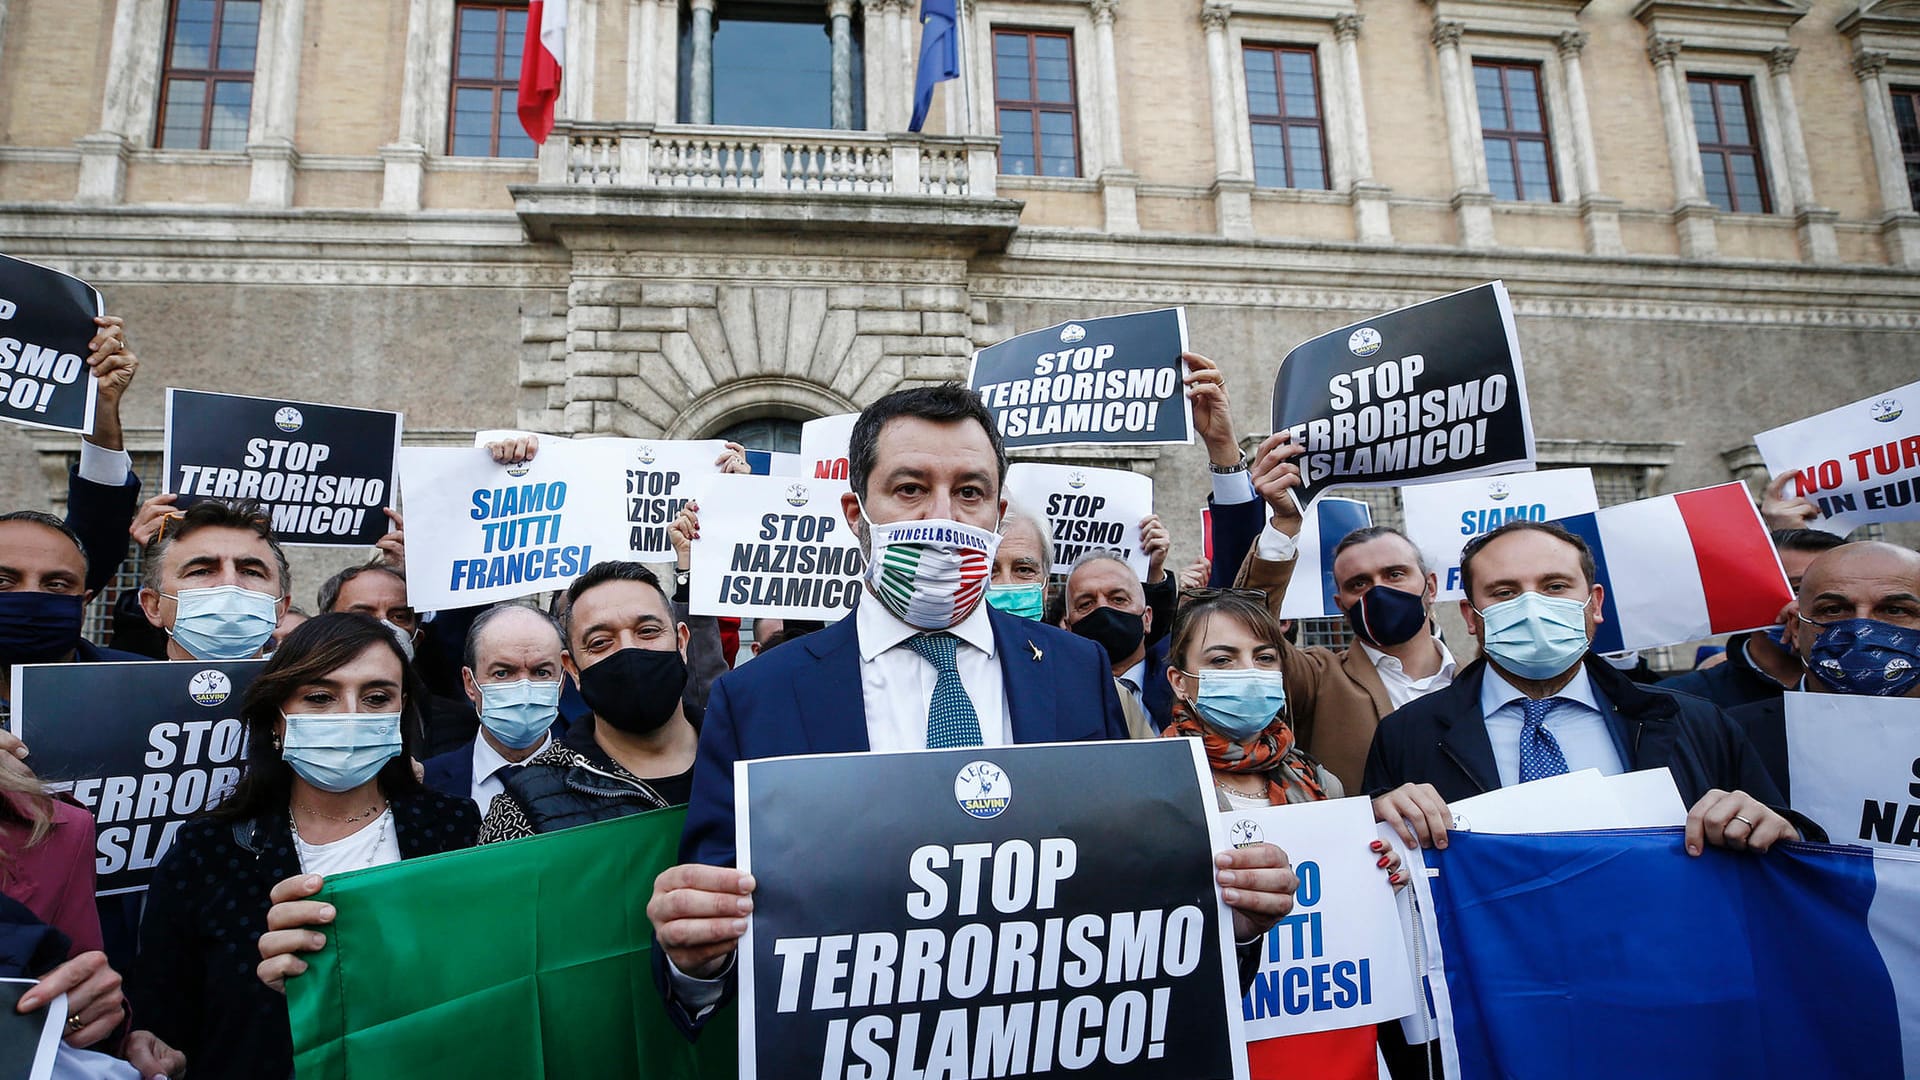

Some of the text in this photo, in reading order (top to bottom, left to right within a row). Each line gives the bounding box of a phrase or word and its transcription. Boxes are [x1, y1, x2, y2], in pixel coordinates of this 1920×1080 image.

[1034, 344, 1114, 377] STOP
[979, 367, 1177, 408] TERRORISMO
[1328, 354, 1425, 411] STOP
[997, 401, 1160, 438] ISLAMICO!
[1282, 374, 1508, 453] ERRORISMO
[244, 438, 330, 472] STOP
[1300, 418, 1488, 489] ISLAMICO!
[179, 465, 384, 507] TERRORISMO
[1793, 459, 1843, 498] NO
[470, 481, 567, 520] SIAMO
[1046, 493, 1106, 518] STOP
[1816, 477, 1920, 520] IN EU
[260, 503, 366, 536] MICO!
[482, 514, 562, 555] TUTTI
[759, 512, 836, 543] STOP
[1048, 519, 1125, 544] ZISMO
[1461, 503, 1546, 535] SIAMO
[450, 545, 592, 591] FRANCESI
[730, 543, 862, 577] NAZISMO
[718, 575, 863, 609] ISLAMICO
[193, 671, 225, 684] LEGA
[960, 764, 1001, 784] LEGA
[965, 799, 1005, 810] SALVINI
[906, 837, 1078, 921] STOP
[773, 905, 1204, 1014] TERRORISMO
[820, 986, 1171, 1080] ISLAMICO!
